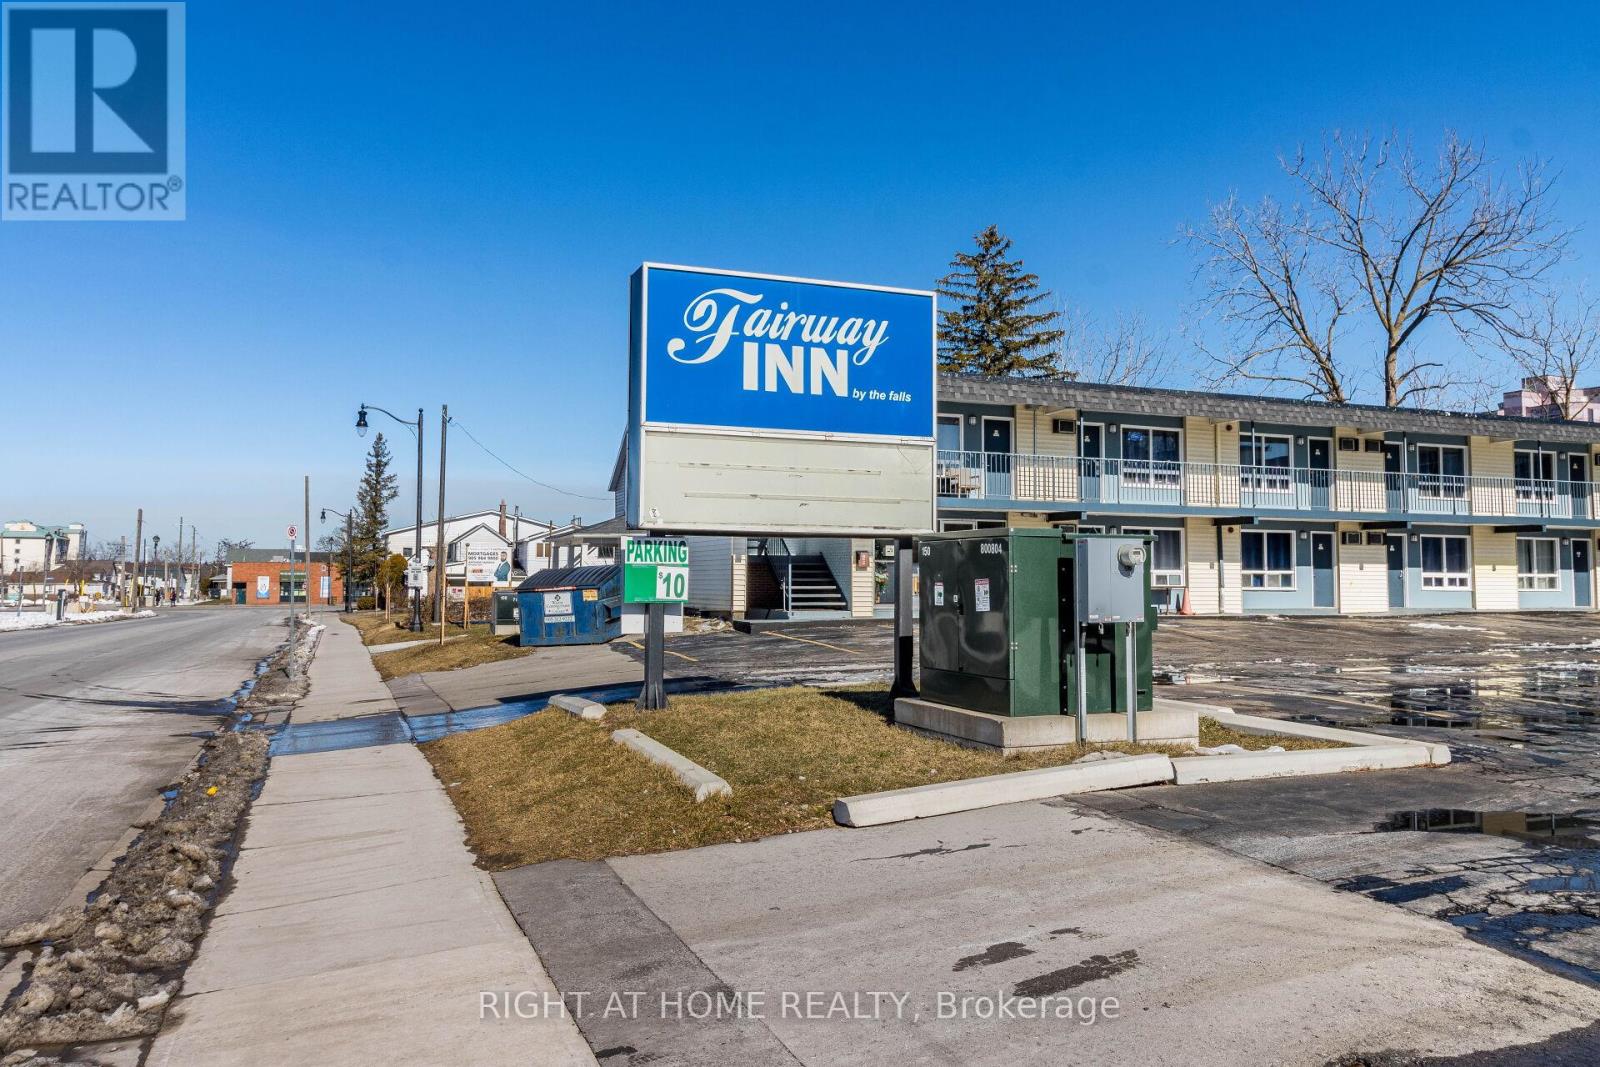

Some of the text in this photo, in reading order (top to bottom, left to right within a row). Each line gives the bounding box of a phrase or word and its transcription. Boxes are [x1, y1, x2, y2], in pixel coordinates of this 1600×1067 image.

[667, 288, 889, 366] Fairway
[742, 341, 849, 398] INN
[852, 388, 912, 402] by the falls
[626, 539, 687, 563] PARKING
